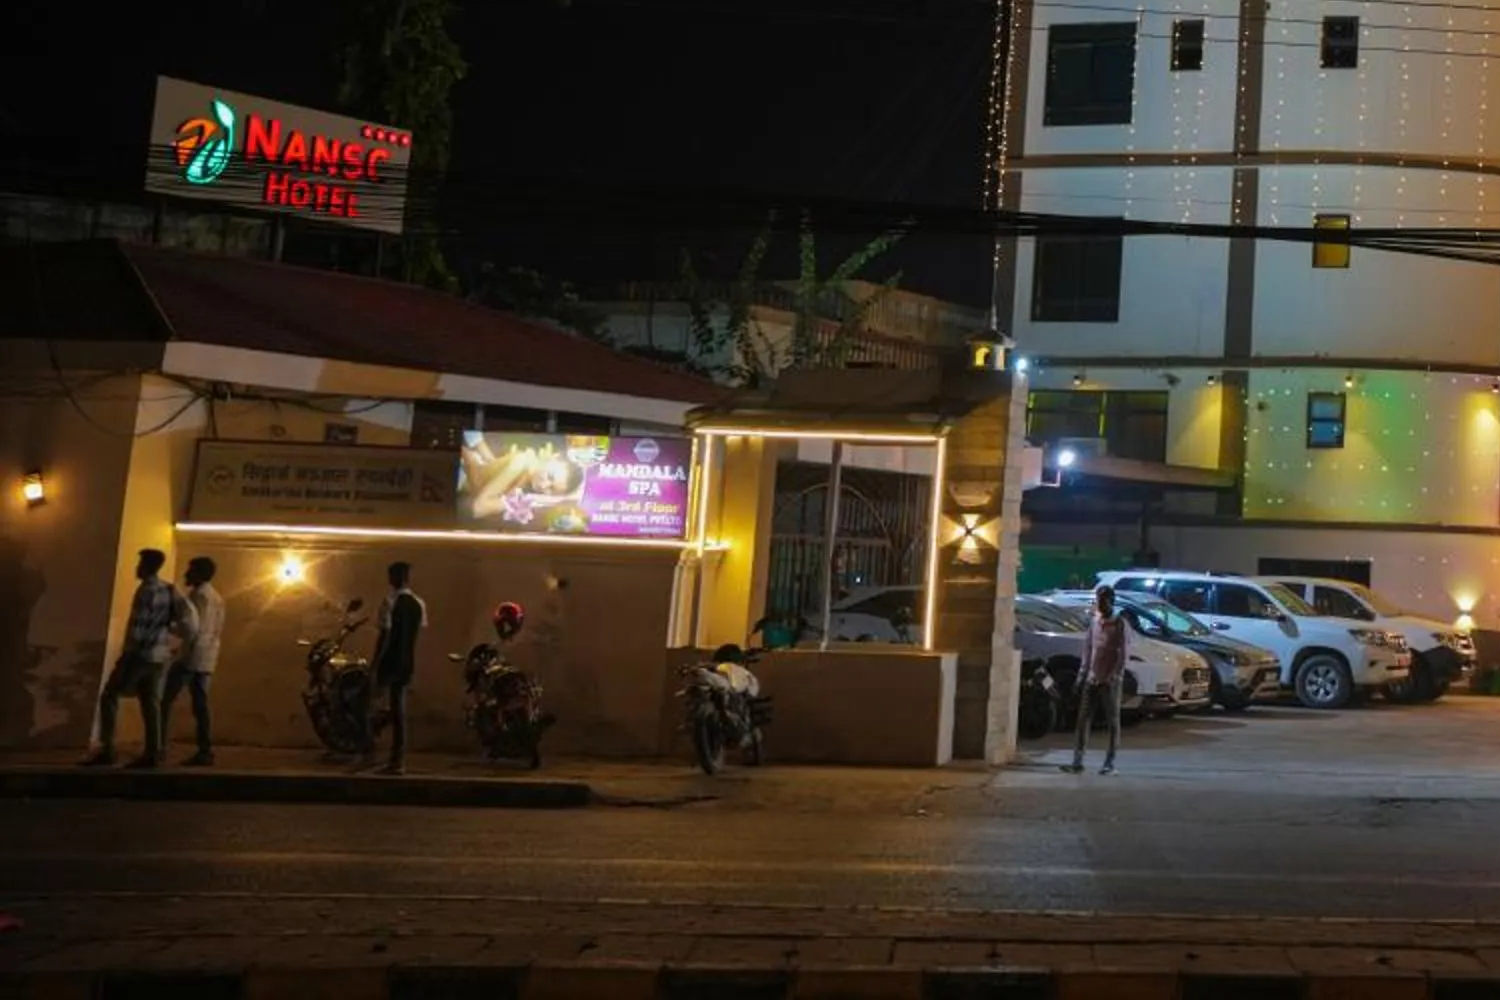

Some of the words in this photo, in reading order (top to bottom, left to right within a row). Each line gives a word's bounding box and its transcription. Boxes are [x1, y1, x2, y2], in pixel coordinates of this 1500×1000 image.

[246, 113, 392, 181] NANSC
[264, 171, 360, 217] HOTEL
[598, 463, 687, 480] MANDALA
[627, 480, 661, 497] SPA
